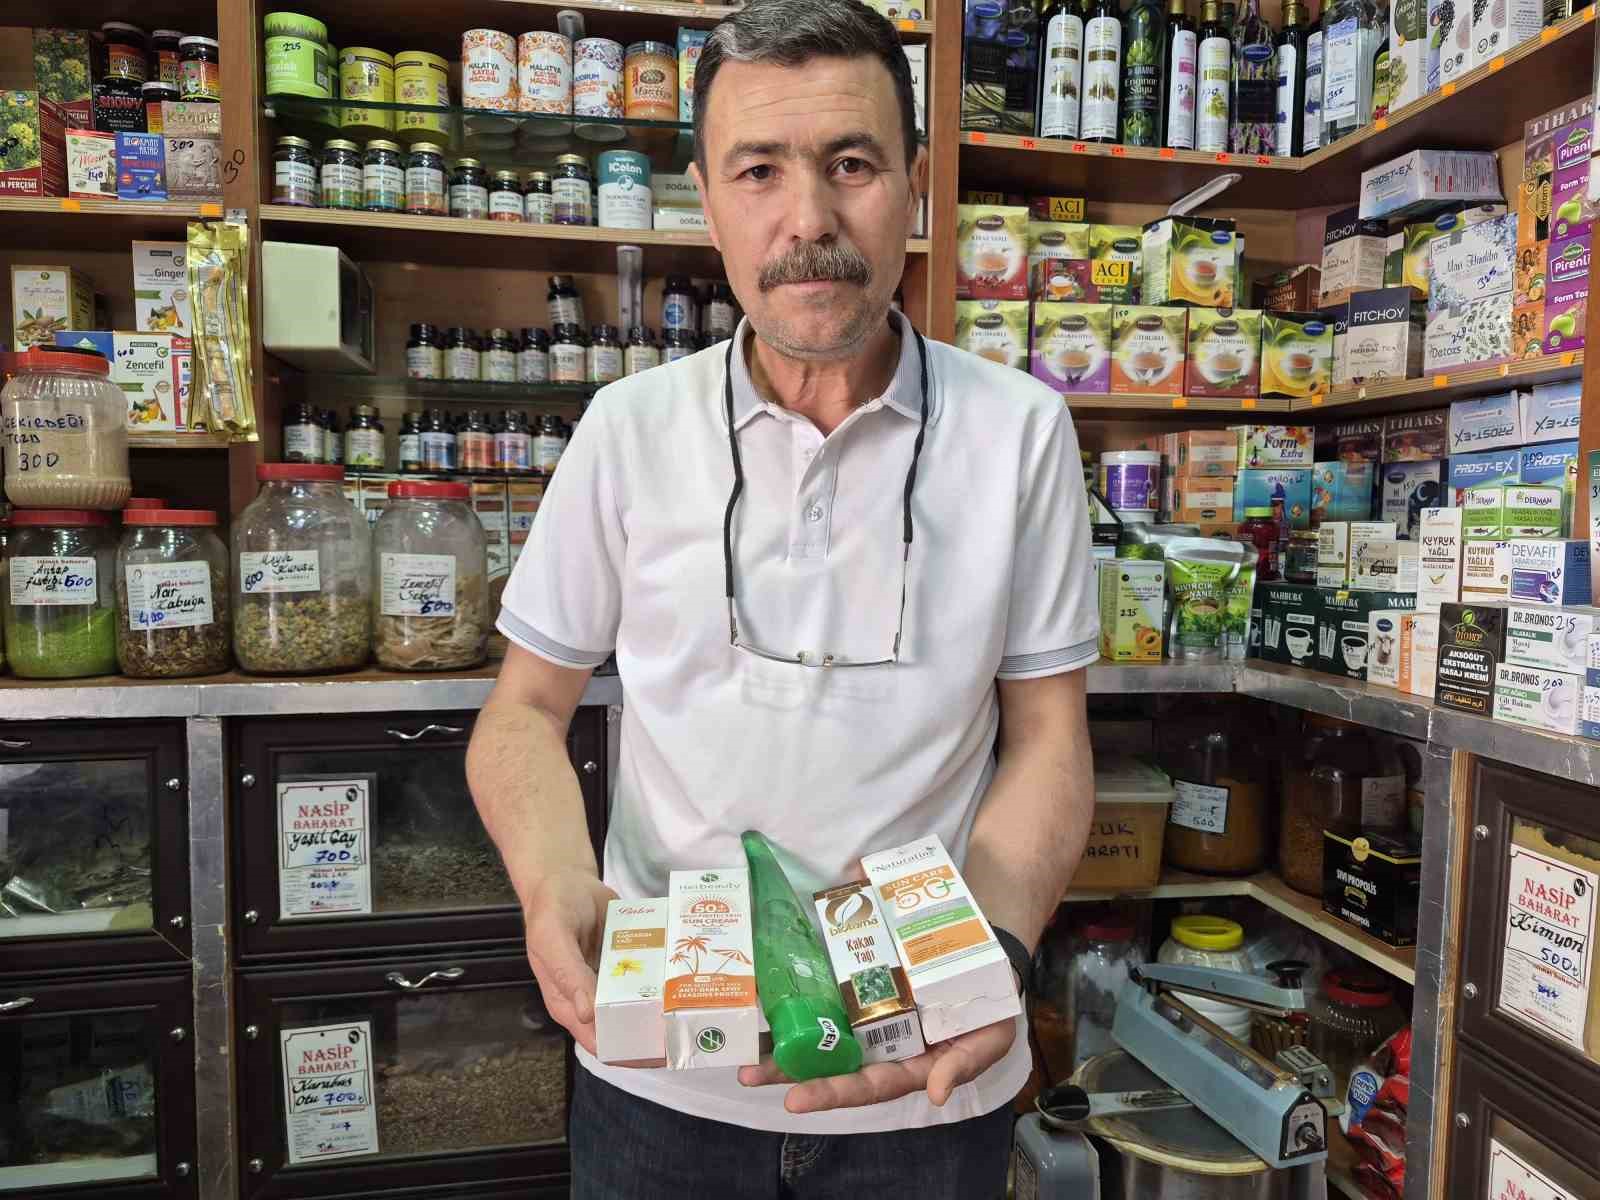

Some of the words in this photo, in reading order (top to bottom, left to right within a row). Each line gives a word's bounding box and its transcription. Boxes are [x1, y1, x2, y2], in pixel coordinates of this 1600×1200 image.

[1054, 200, 1081, 213] ACI
[154, 267, 186, 279] Ginger
[1095, 264, 1126, 279] ACI
[1353, 308, 1405, 324] FITCHOY
[126, 360, 164, 370] Zencefil
[1264, 432, 1297, 449] Form
[18, 452, 60, 471] 300
[1453, 457, 1514, 475] PROST-EX
[1525, 496, 1553, 506] DERMAN
[1422, 536, 1455, 546] KUYRUK
[1428, 547, 1449, 556] YAĞLI
[1467, 547, 1495, 556] KUYRUK
[64, 575, 93, 588] 500
[150, 583, 181, 599] Nar
[298, 800, 350, 818] NASİP
[293, 818, 355, 830] BAHARAT
[1523, 878, 1576, 910] NASİP
[695, 903, 729, 914] 50+
[1518, 895, 1581, 928] BAHARAT
[846, 935, 875, 952] Kakao
[822, 1020, 837, 1048] OPEN
[303, 1043, 353, 1064] NASİP
[298, 1060, 359, 1075] BAHARAT
